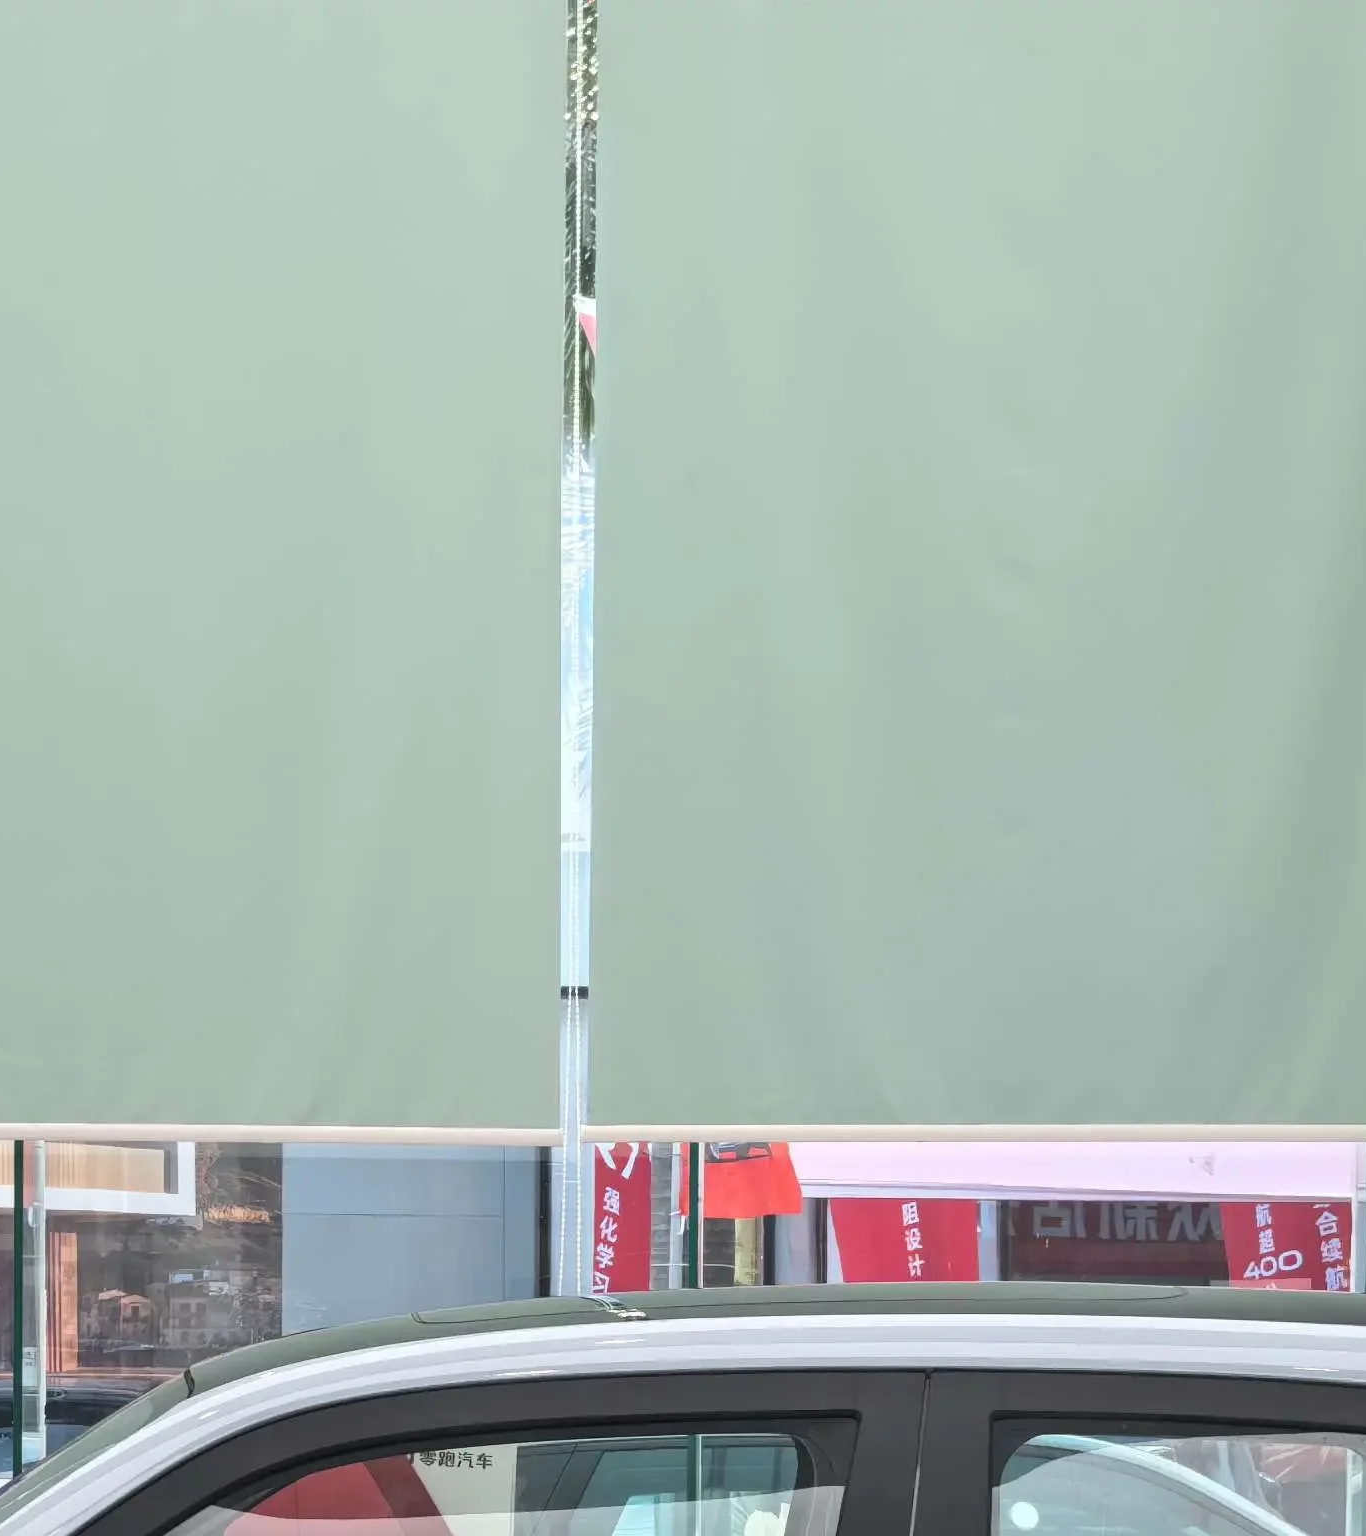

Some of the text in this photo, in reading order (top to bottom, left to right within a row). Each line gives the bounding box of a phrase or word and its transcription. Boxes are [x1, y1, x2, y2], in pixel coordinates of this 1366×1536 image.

[1243, 1249, 1304, 1280] 400
[419, 1450, 493, 1469] 零跑汽车
